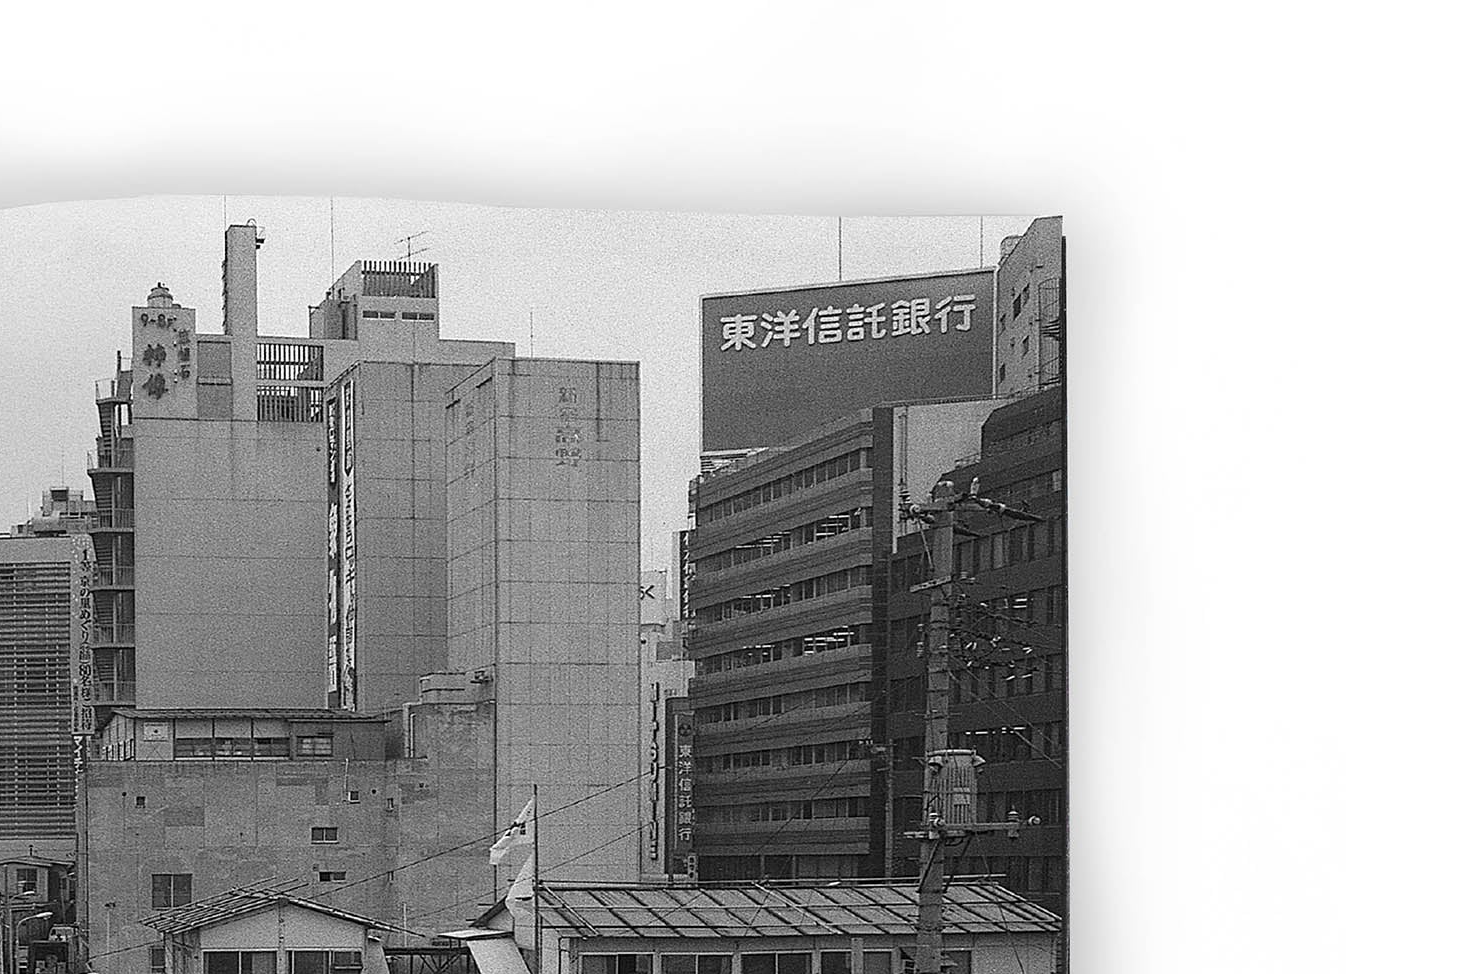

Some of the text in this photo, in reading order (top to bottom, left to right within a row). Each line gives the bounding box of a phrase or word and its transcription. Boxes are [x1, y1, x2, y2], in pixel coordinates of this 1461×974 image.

[719, 294, 977, 351] 東洋信託銀行
[679, 744, 692, 842] 東洋信託銀行
